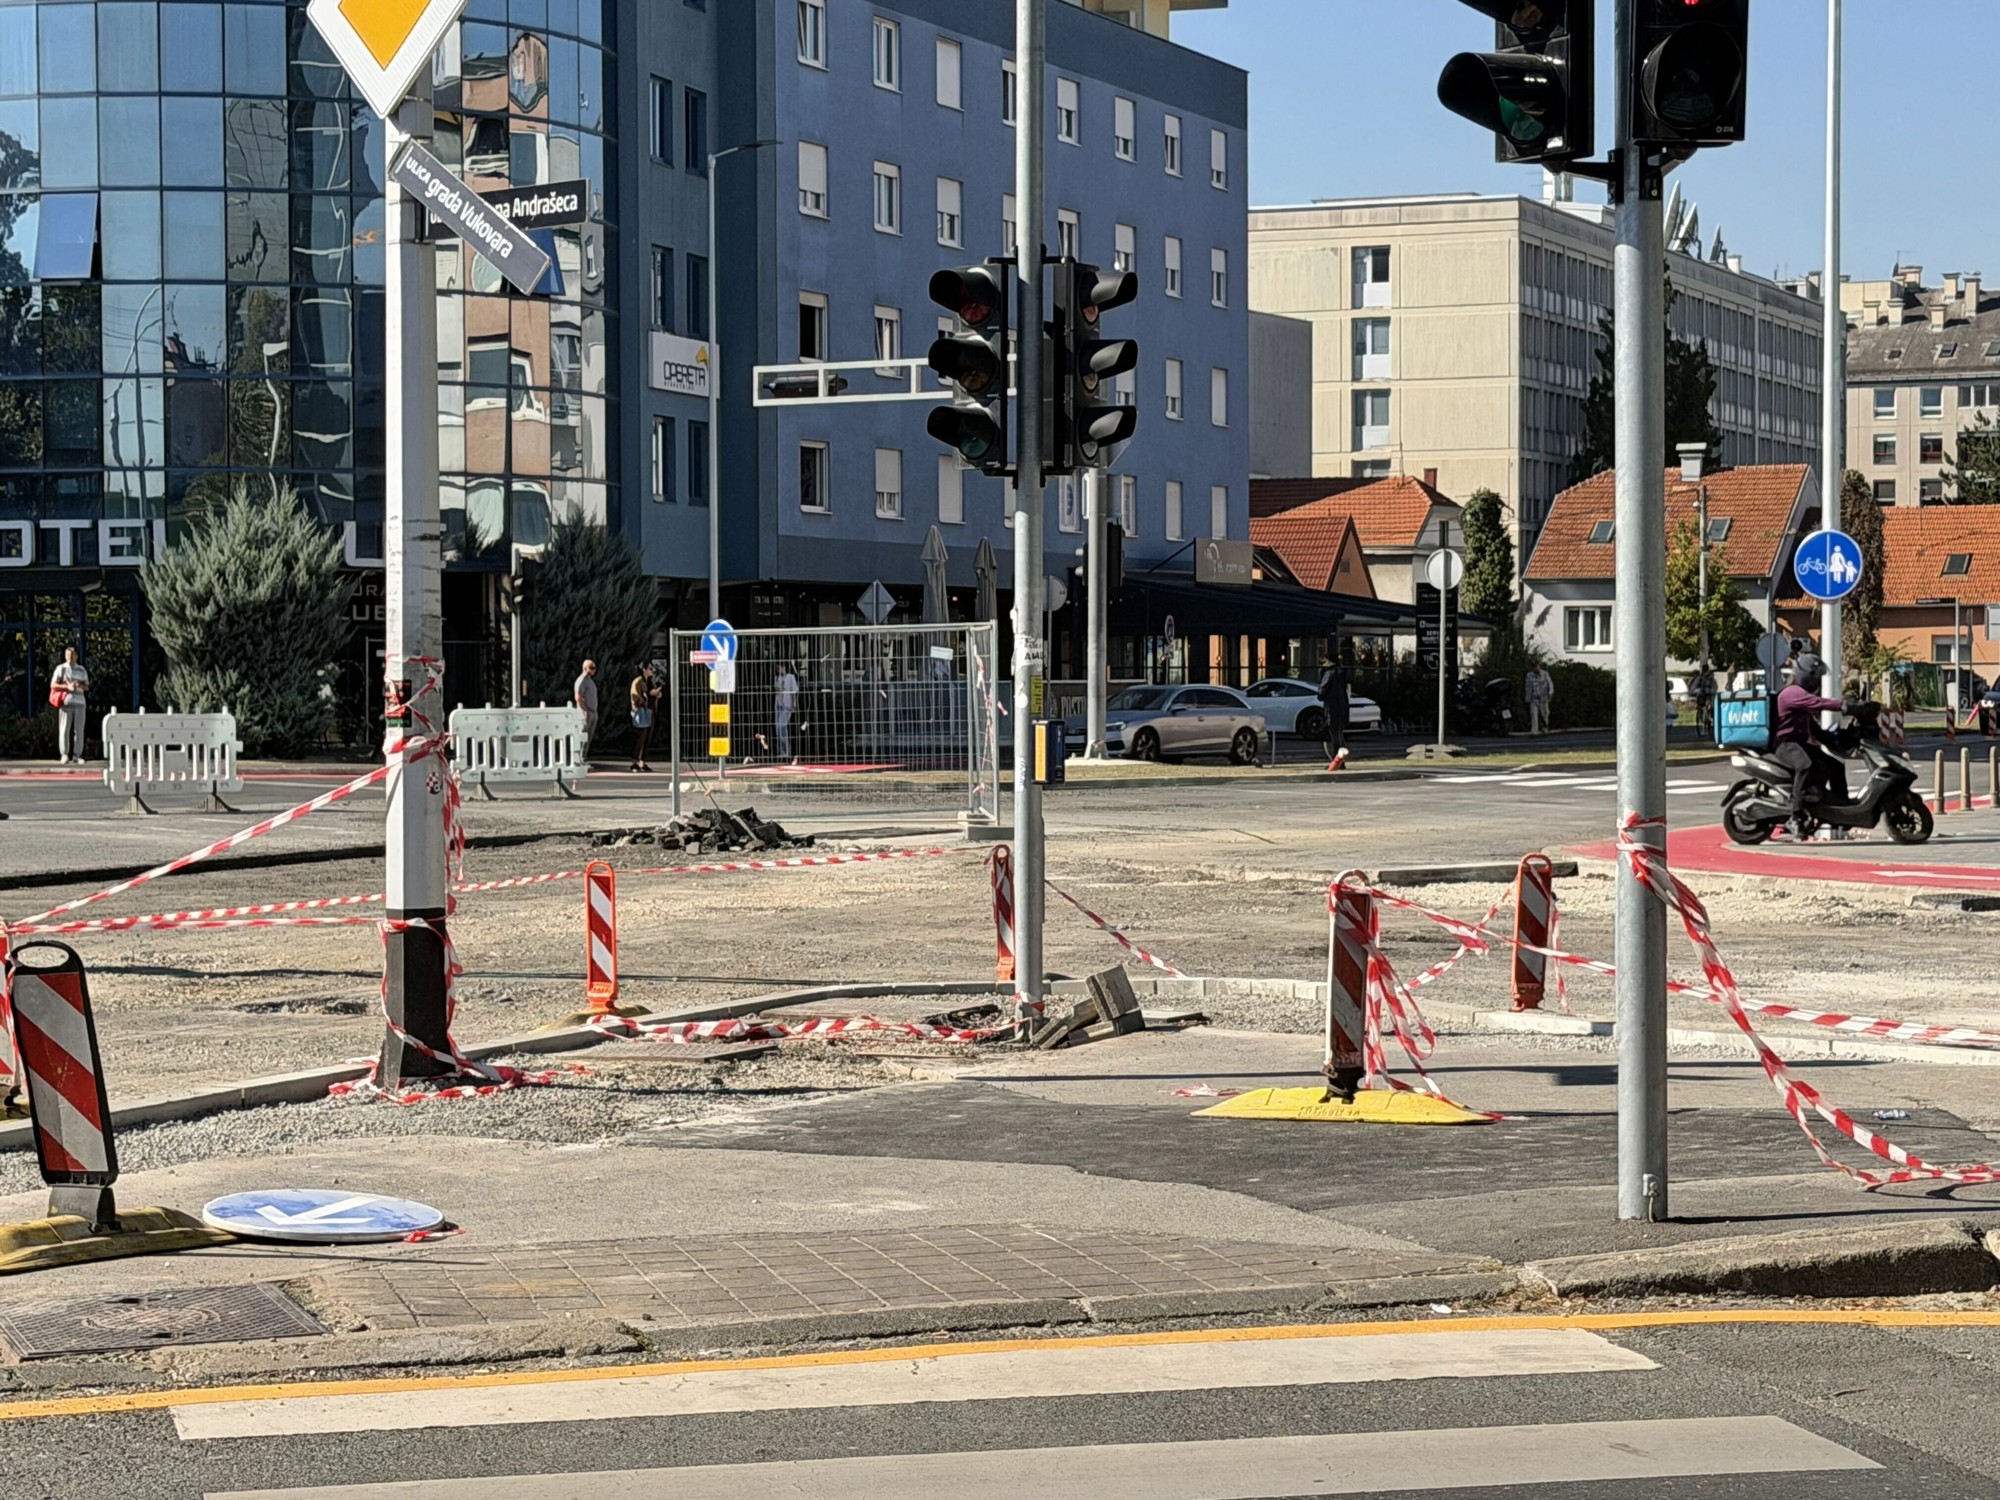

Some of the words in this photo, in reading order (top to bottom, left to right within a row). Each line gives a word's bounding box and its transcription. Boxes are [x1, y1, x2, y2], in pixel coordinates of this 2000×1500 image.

[405, 157, 432, 183] ULICA
[424, 178, 463, 216] grada
[460, 201, 514, 259] Vukovara
[512, 191, 578, 218] Andrašeca
[663, 360, 706, 387] OPERETA
[1728, 709, 1759, 725] Wolt
